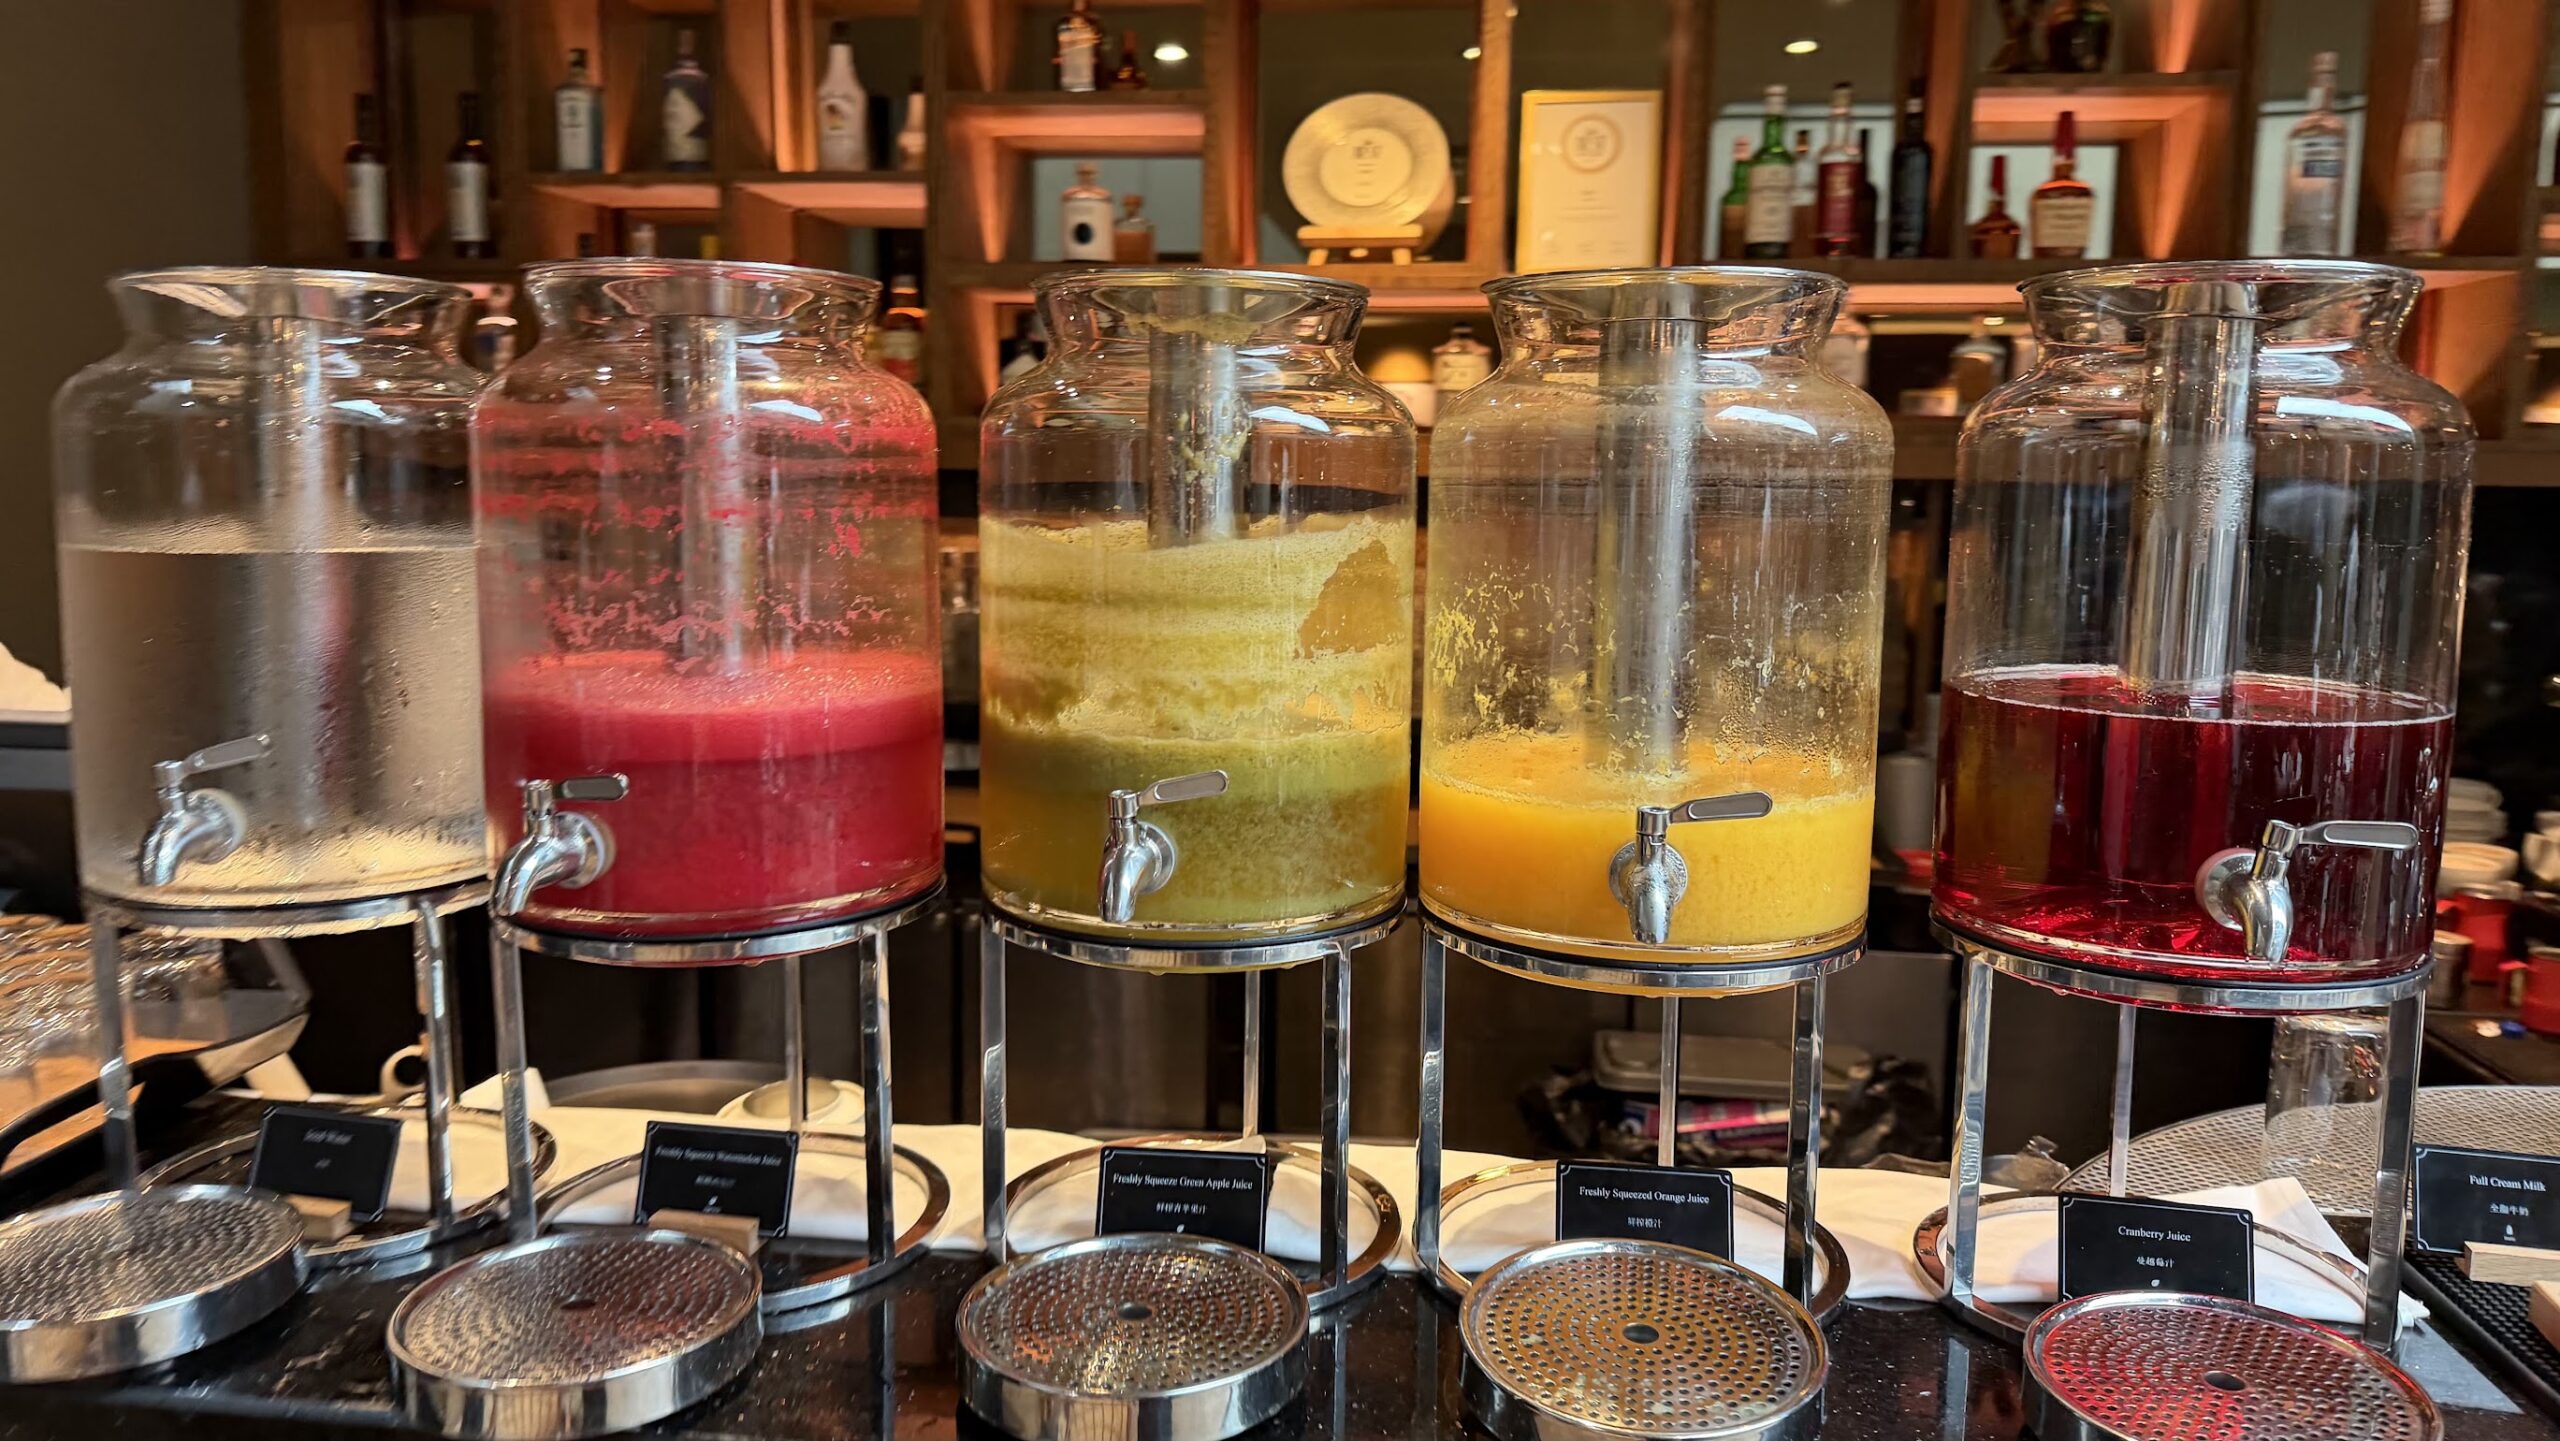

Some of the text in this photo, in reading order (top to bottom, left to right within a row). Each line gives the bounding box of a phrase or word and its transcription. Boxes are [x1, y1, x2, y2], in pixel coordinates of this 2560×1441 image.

[1113, 1172, 1254, 1191] Freshly Squeeze Green Apple Juice
[2469, 1174, 2547, 1192] Full Cream Milk
[1579, 1185, 1710, 1205] Freshly Squeezed Orange Juice
[2117, 1225, 2192, 1243] Cranberry Juice
